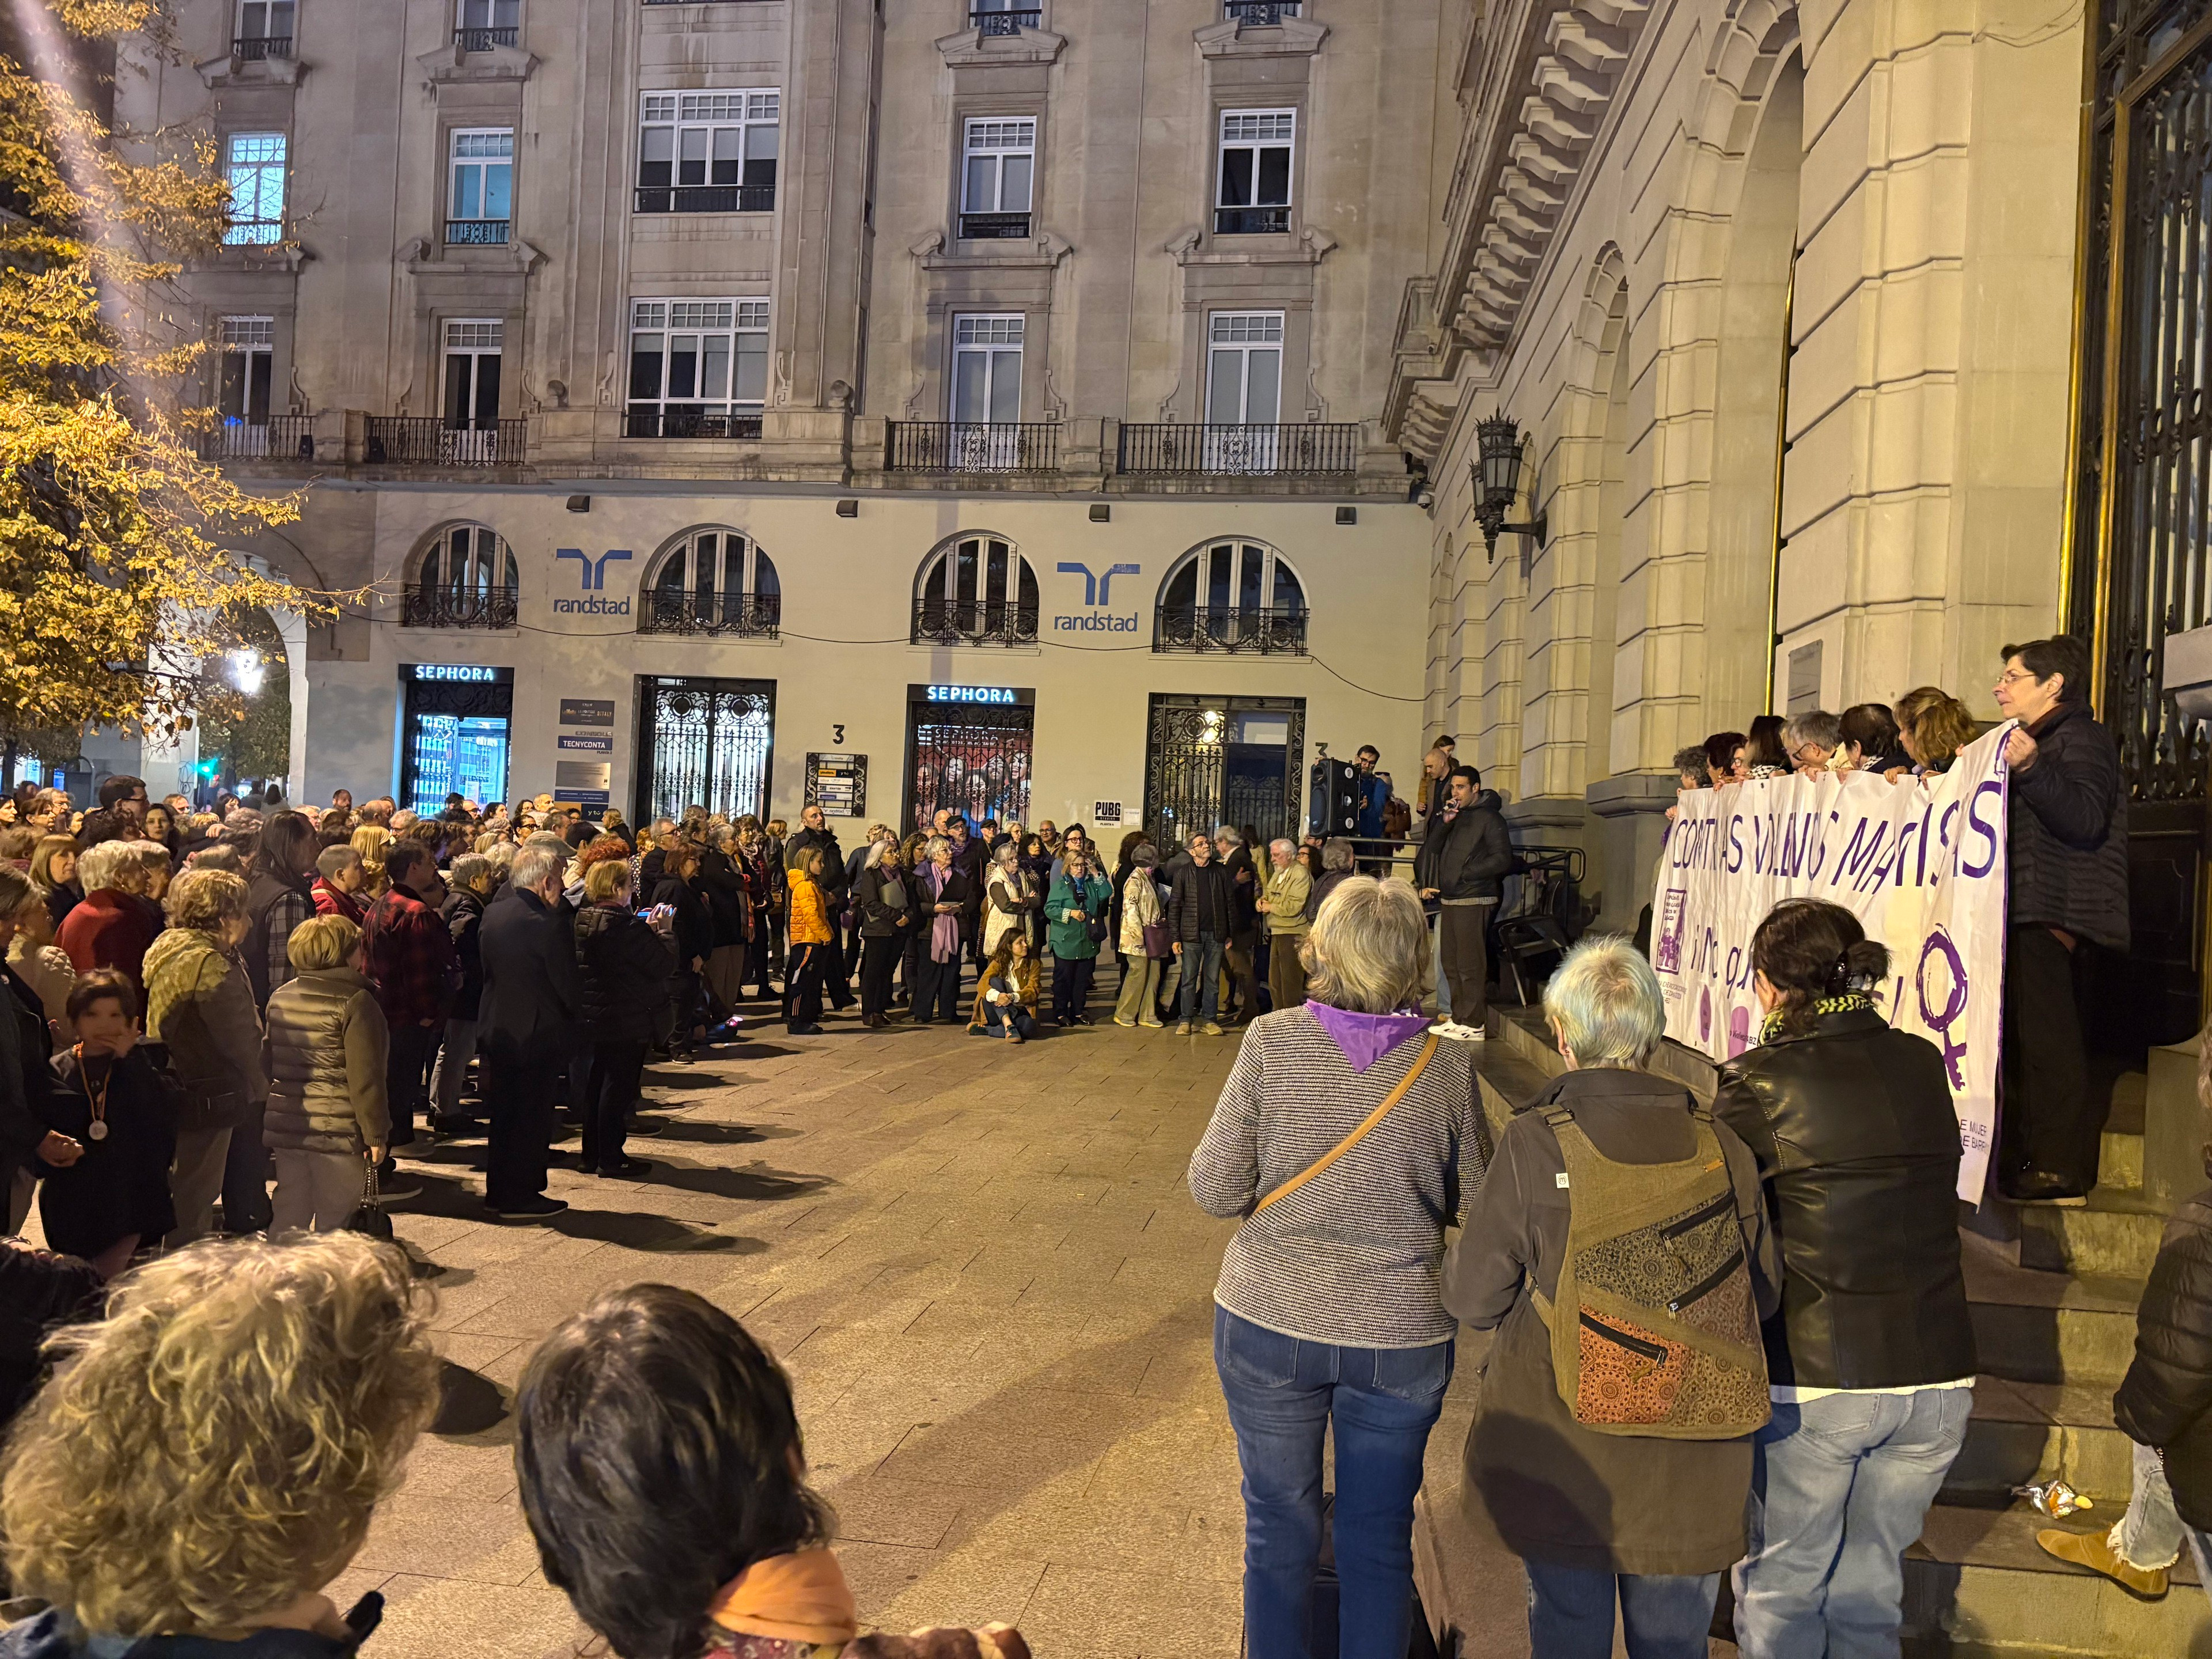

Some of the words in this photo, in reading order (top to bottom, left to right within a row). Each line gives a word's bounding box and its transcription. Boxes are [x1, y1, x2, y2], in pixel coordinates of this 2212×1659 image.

[553, 594, 630, 615] randstad
[1054, 611, 1138, 632] randstad
[415, 666, 494, 681] SEPHORA
[927, 686, 1014, 702] SEPHORA
[832, 724, 845, 744] 3
[935, 728, 998, 740] SEPHORA
[563, 740, 605, 748] TECNYCONTA
[1095, 802, 1121, 816] PUBG
